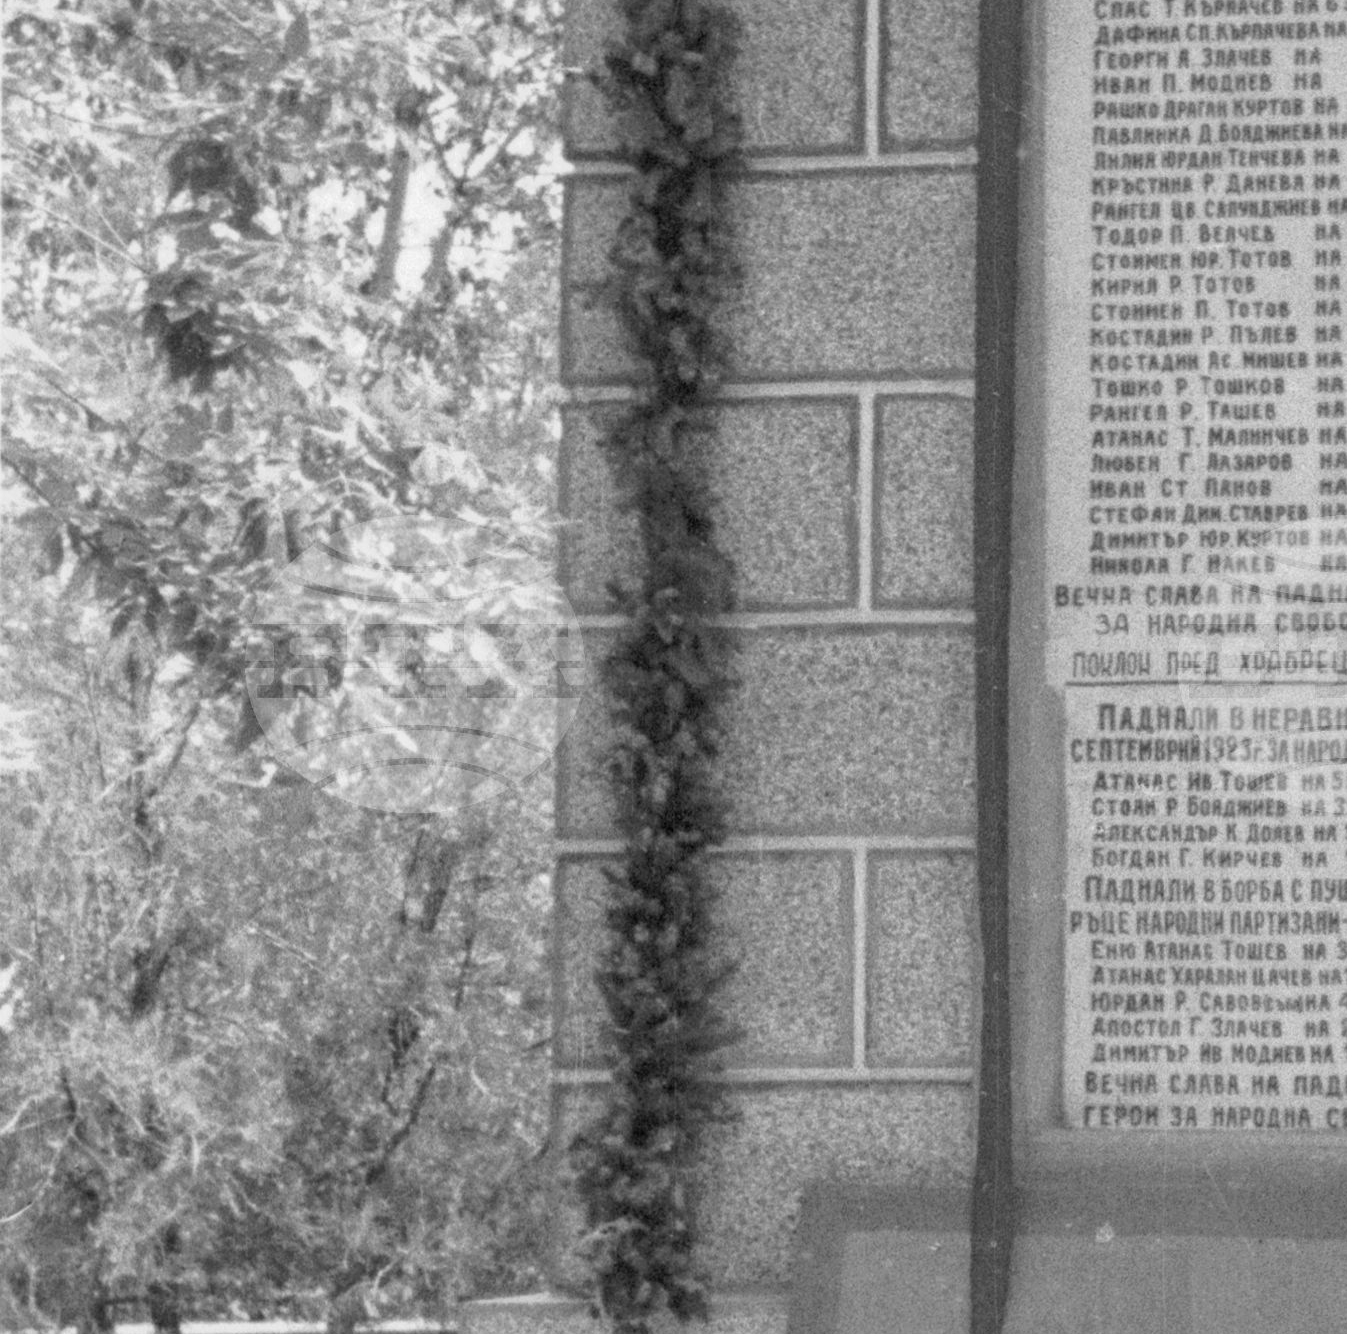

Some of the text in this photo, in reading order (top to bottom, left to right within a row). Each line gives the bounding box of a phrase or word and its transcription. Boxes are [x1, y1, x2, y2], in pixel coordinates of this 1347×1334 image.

[1094, 21, 1347, 46] ДАФИНА НА
[1094, 49, 1169, 70] ГЕОРГИ
[1294, 47, 1320, 65] НА
[1094, 76, 1150, 94] ИВАН
[1294, 72, 1321, 90] НА
[1094, 100, 1158, 120] РАШКО
[1165, 100, 1227, 120] ДРАГАН
[1233, 98, 1302, 117] КУРТОВ
[1314, 97, 1338, 115] НА
[1328, 123, 1347, 139] НА
[1314, 148, 1339, 165] НА
[1092, 177, 1192, 195] КРЪСТИНА
[1314, 174, 1340, 190] НА
[1092, 223, 1341, 247] ТОДОР НА
[1228, 248, 1292, 268] ТОТОВ
[1315, 249, 1341, 266] НА
[1193, 274, 1340, 293] ТОТОВ НА
[1226, 299, 1341, 318] ТОТОВ НА
[1090, 324, 1341, 347] КОСТАДИН НА
[1090, 354, 1198, 372] КОСТАДИН
[1316, 351, 1342, 367] НА
[1092, 378, 1162, 398] ТОШКО
[1200, 375, 1284, 395] ТОШКОВ
[1317, 376, 1343, 393] НА
[1090, 404, 1167, 422] РАНГЕЛ
[1317, 400, 1345, 417] НА
[1092, 429, 1167, 448] АТАНАС
[1319, 427, 1346, 444] НА
[1091, 452, 1347, 472] ЛЮБЕН ЛАЗАРОВ НА
[1090, 479, 1145, 498] ИВАН
[1205, 477, 1271, 497] ПАНОВ
[1320, 478, 1347, 495] НА
[1090, 505, 1176, 524] СТЕФАН
[1320, 503, 1347, 518] НА
[1090, 531, 1189, 552] ДИМИТЪР
[1320, 529, 1347, 546] НА
[1056, 584, 1131, 608] ВЕЧНА
[1146, 584, 1218, 606] СЛАВА
[1232, 584, 1261, 604] НА
[1096, 613, 1129, 635] ЗА
[1149, 613, 1256, 635] НАРОДНА
[1073, 651, 1219, 677] ПОКЛОН ПРЕД
[1099, 703, 1218, 734] ПАДНАЛИ
[1231, 706, 1244, 730] В
[1093, 771, 1176, 791] АТАНАС
[1302, 773, 1325, 791] НА
[1092, 797, 1156, 816] СТОЯН
[1302, 799, 1325, 816] НА
[1093, 823, 1337, 842] АЛЕКСАНДЪР НА
[1092, 847, 1169, 869] БОГДАН
[1204, 848, 1282, 867] КИРЧЕВ
[1302, 852, 1327, 867] НА
[1085, 875, 1195, 905] ПАДНАЛИ
[1204, 879, 1215, 902] В
[1222, 878, 1283, 902] БОРБА
[1291, 878, 1302, 902] С
[1070, 911, 1223, 935] РЪЦЕ НАРОДНИ
[1092, 940, 1135, 959] ЕНЮ
[1145, 940, 1213, 960] АТАНАС
[1221, 940, 1286, 960] ТОШЕВ
[1303, 943, 1326, 960] НА
[1093, 966, 1166, 984] АТАНАС
[1319, 969, 1341, 984] НА
[1092, 992, 1164, 1012] ЮРДАН
[1093, 1017, 1181, 1036] АПОСТОЛ
[1212, 1018, 1281, 1037] ЗЛАЧЕВ
[1306, 1020, 1329, 1037] НА
[1092, 1043, 1189, 1063] ДИМИТЪР
[1311, 1044, 1333, 1063] НА
[1086, 1071, 1157, 1094] ВЕЧНА
[1170, 1073, 1238, 1094] СЛАВА
[1252, 1073, 1279, 1095] НА
[1084, 1105, 1158, 1126] ГЕРОИ
[1171, 1106, 1197, 1126] ЗА
[1213, 1105, 1310, 1128] НАРОДНА
